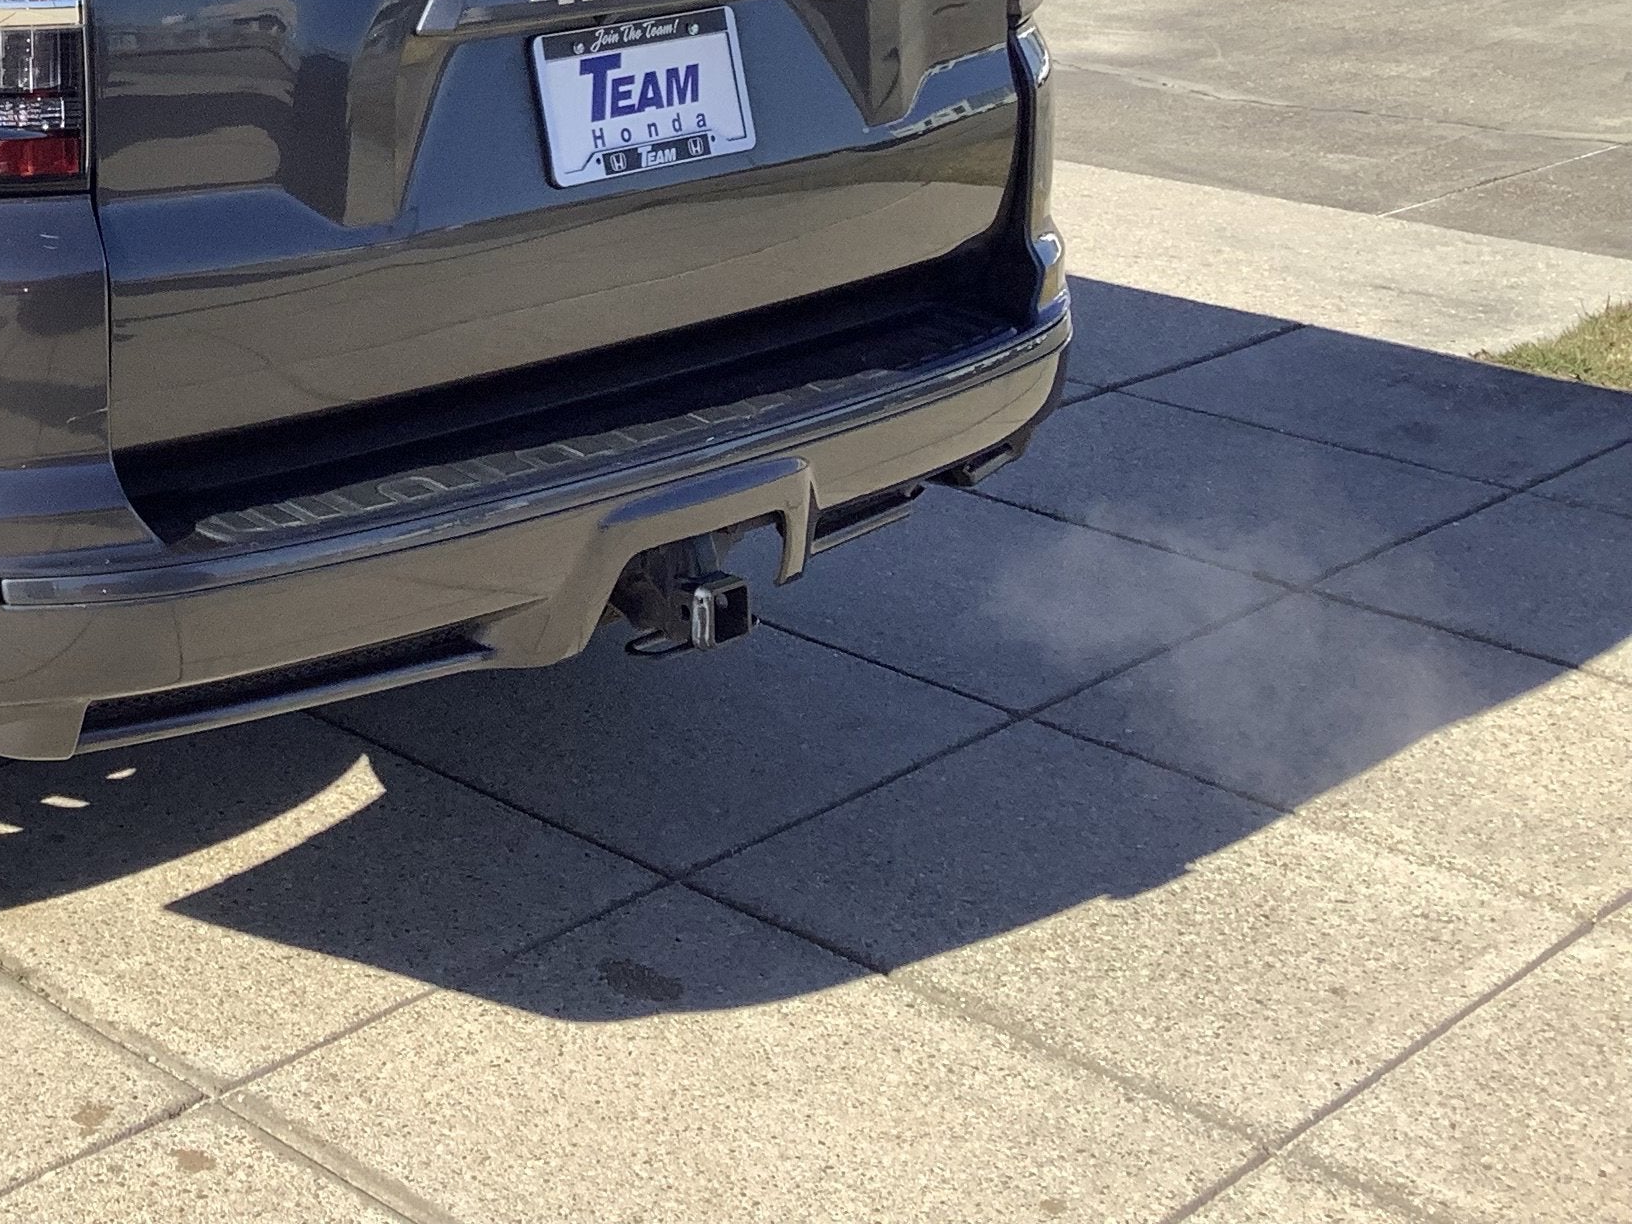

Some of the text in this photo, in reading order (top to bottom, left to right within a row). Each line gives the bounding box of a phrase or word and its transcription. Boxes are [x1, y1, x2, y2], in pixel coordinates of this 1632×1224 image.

[590, 19, 680, 53] Join The Team!
[579, 53, 700, 122] TEAM
[591, 111, 708, 149] Honda
[637, 145, 677, 168] TEAM
